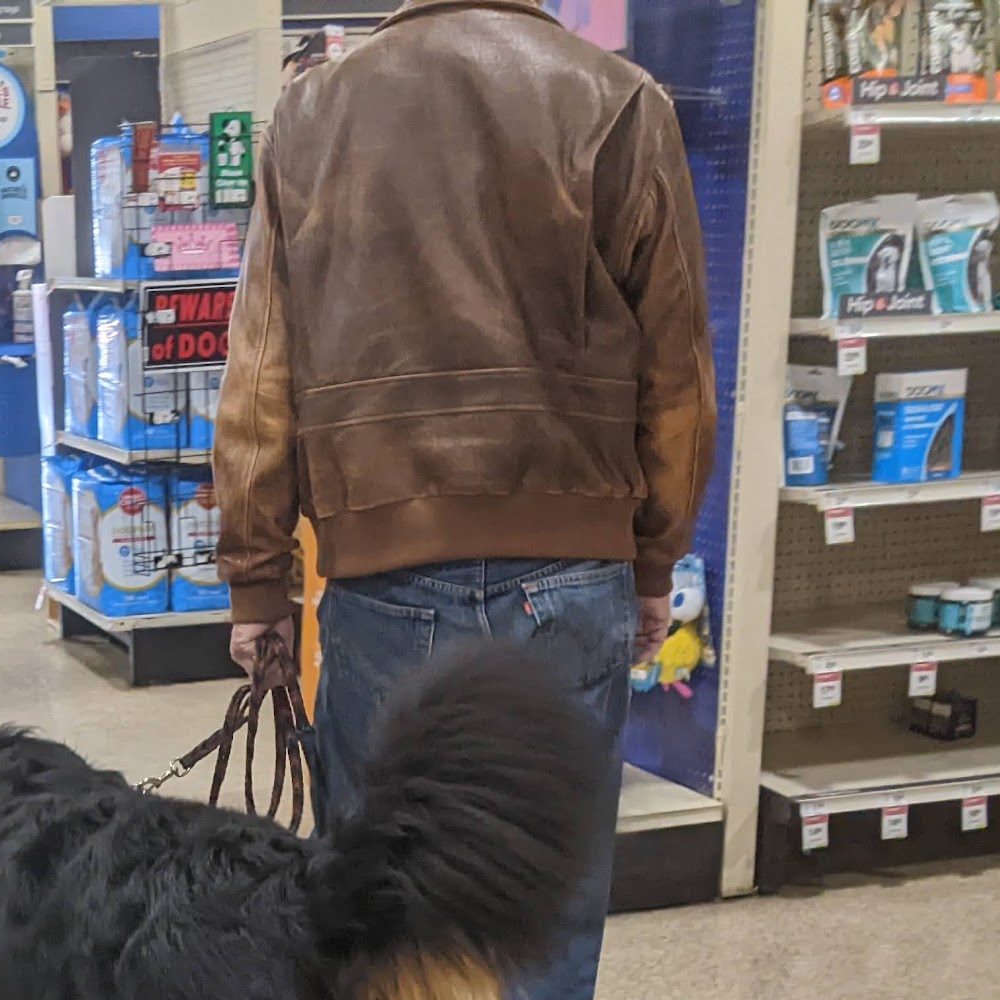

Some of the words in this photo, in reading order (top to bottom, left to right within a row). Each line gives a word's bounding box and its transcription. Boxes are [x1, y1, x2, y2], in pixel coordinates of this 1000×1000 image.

[860, 80, 888, 102] Hip
[900, 79, 940, 97] Joint
[846, 295, 874, 315] Hip
[886, 293, 926, 312] Joint
[152, 334, 174, 361] of
